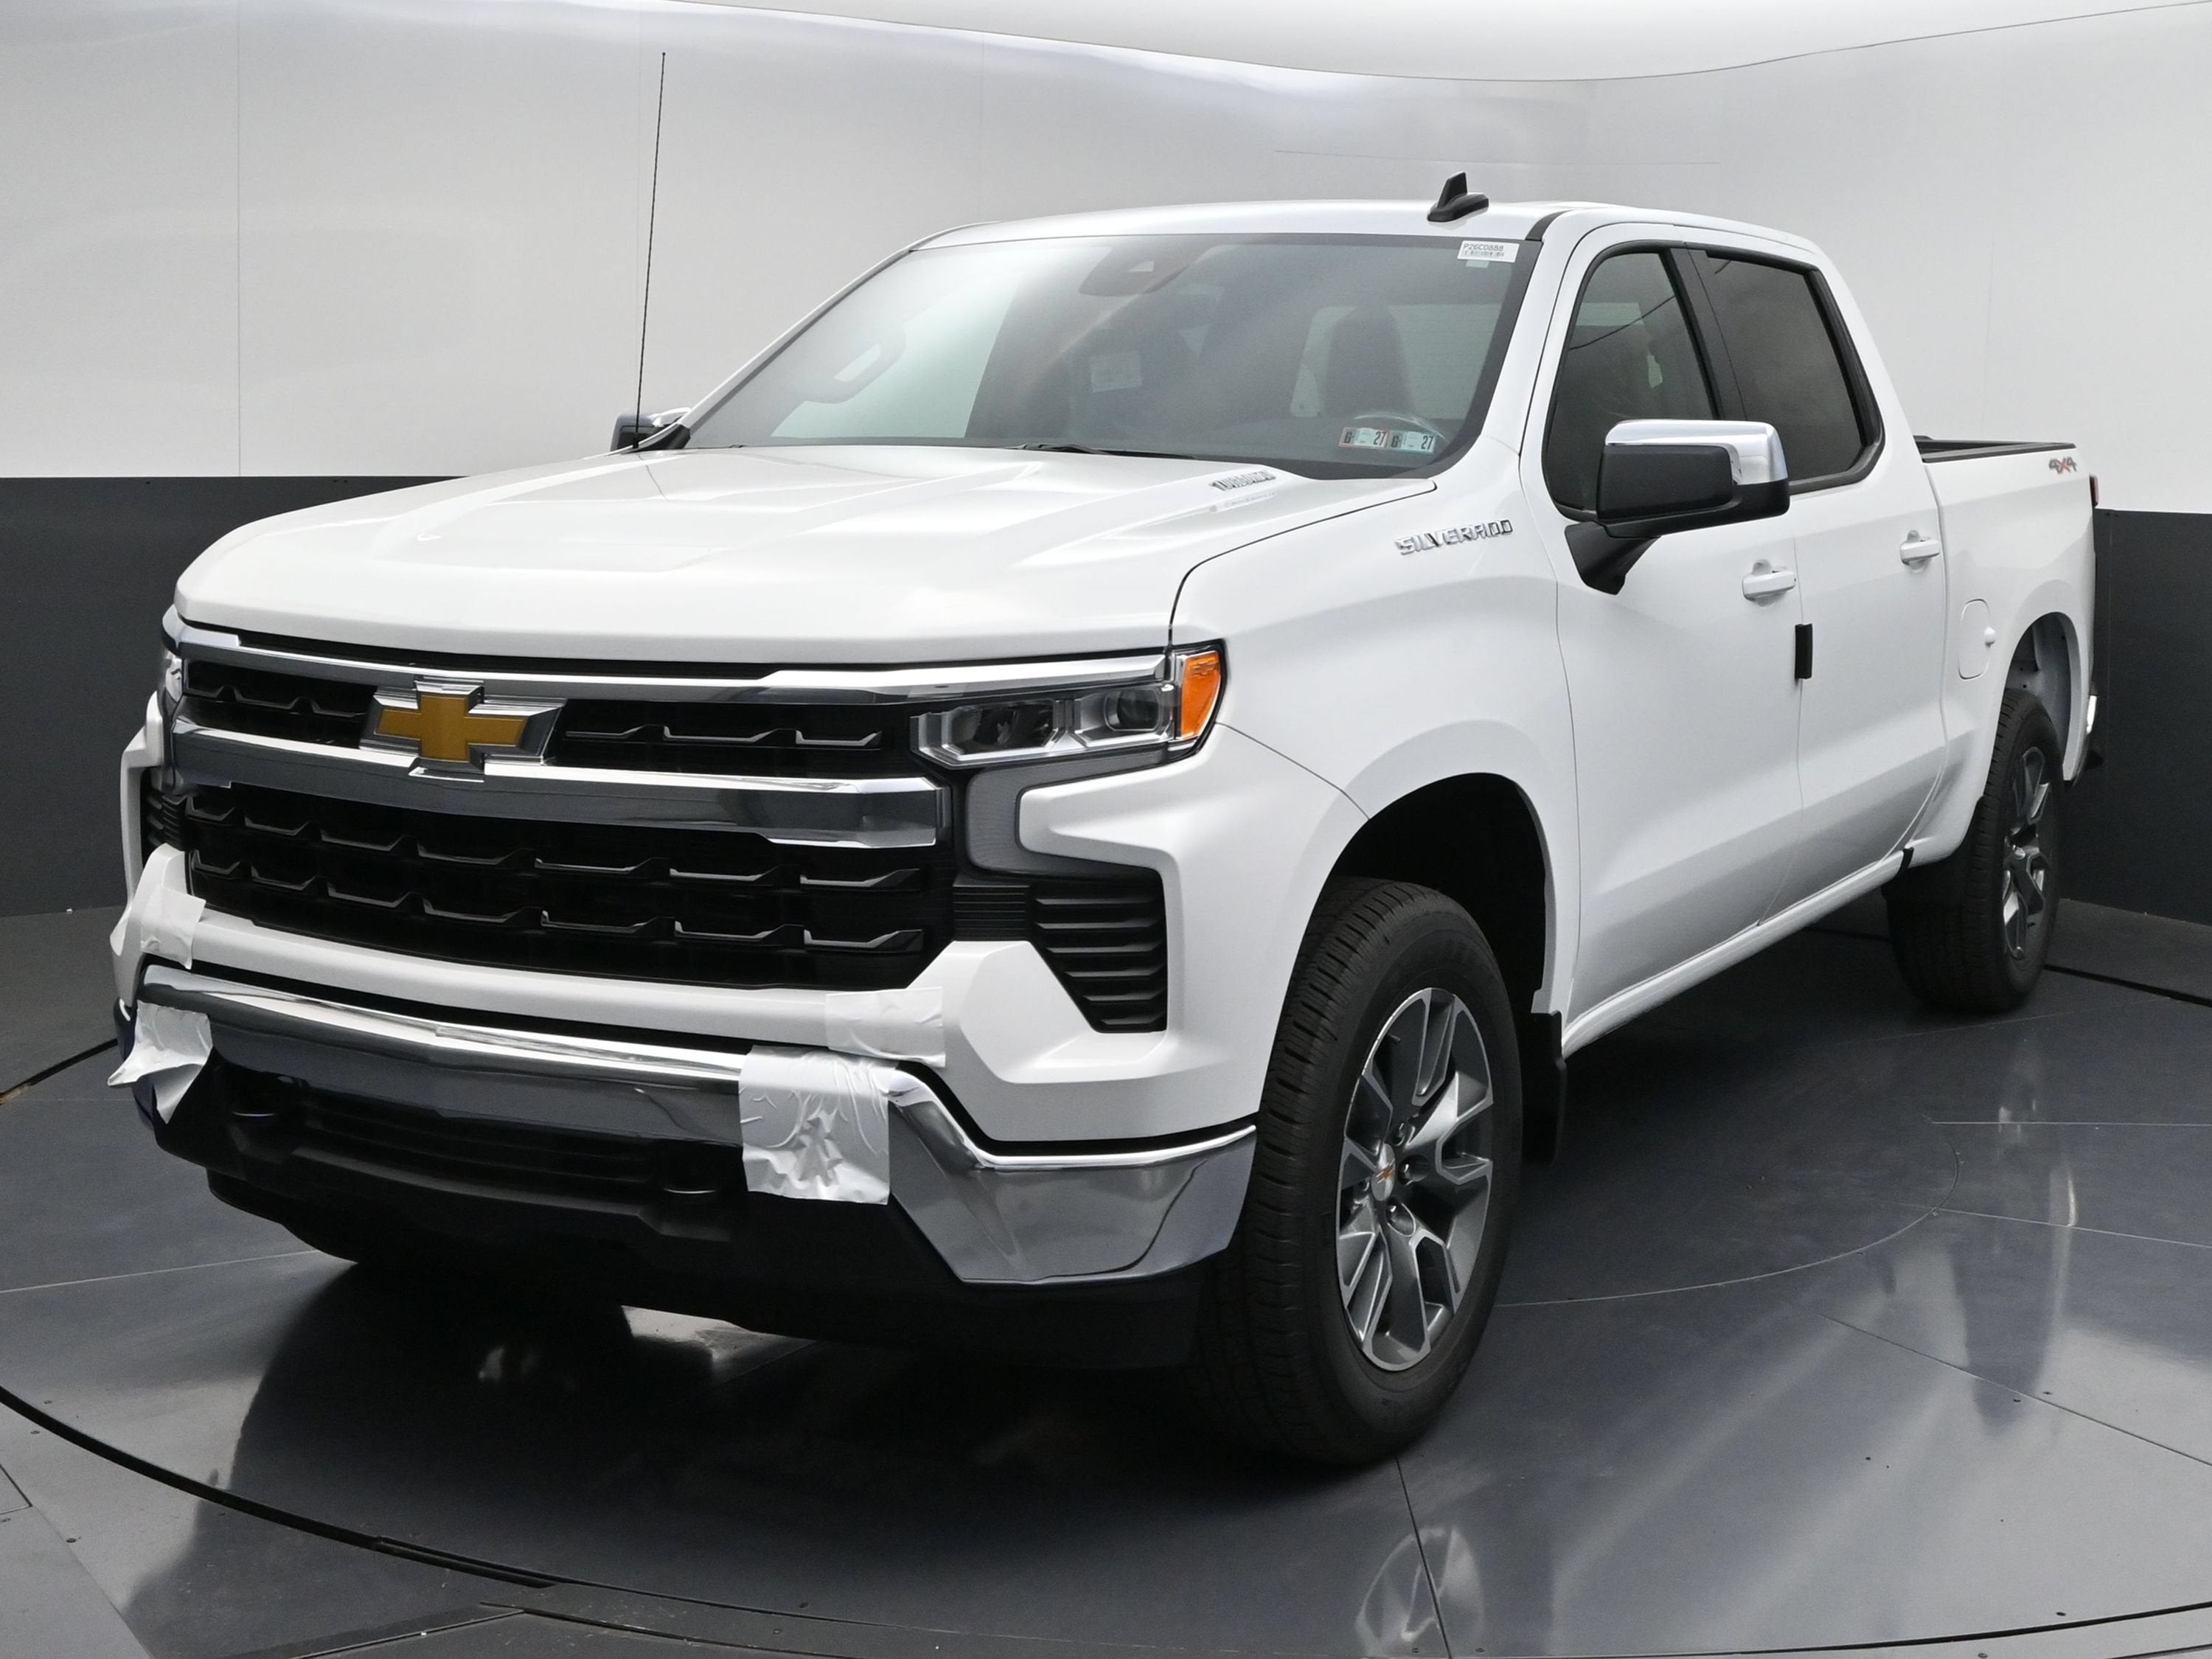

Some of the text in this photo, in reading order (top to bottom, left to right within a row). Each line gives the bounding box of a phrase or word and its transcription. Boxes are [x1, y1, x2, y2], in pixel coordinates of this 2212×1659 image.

[1374, 431, 1387, 446] 27
[1421, 435, 1434, 450] 27
[1394, 519, 1513, 555] SILVERADO
